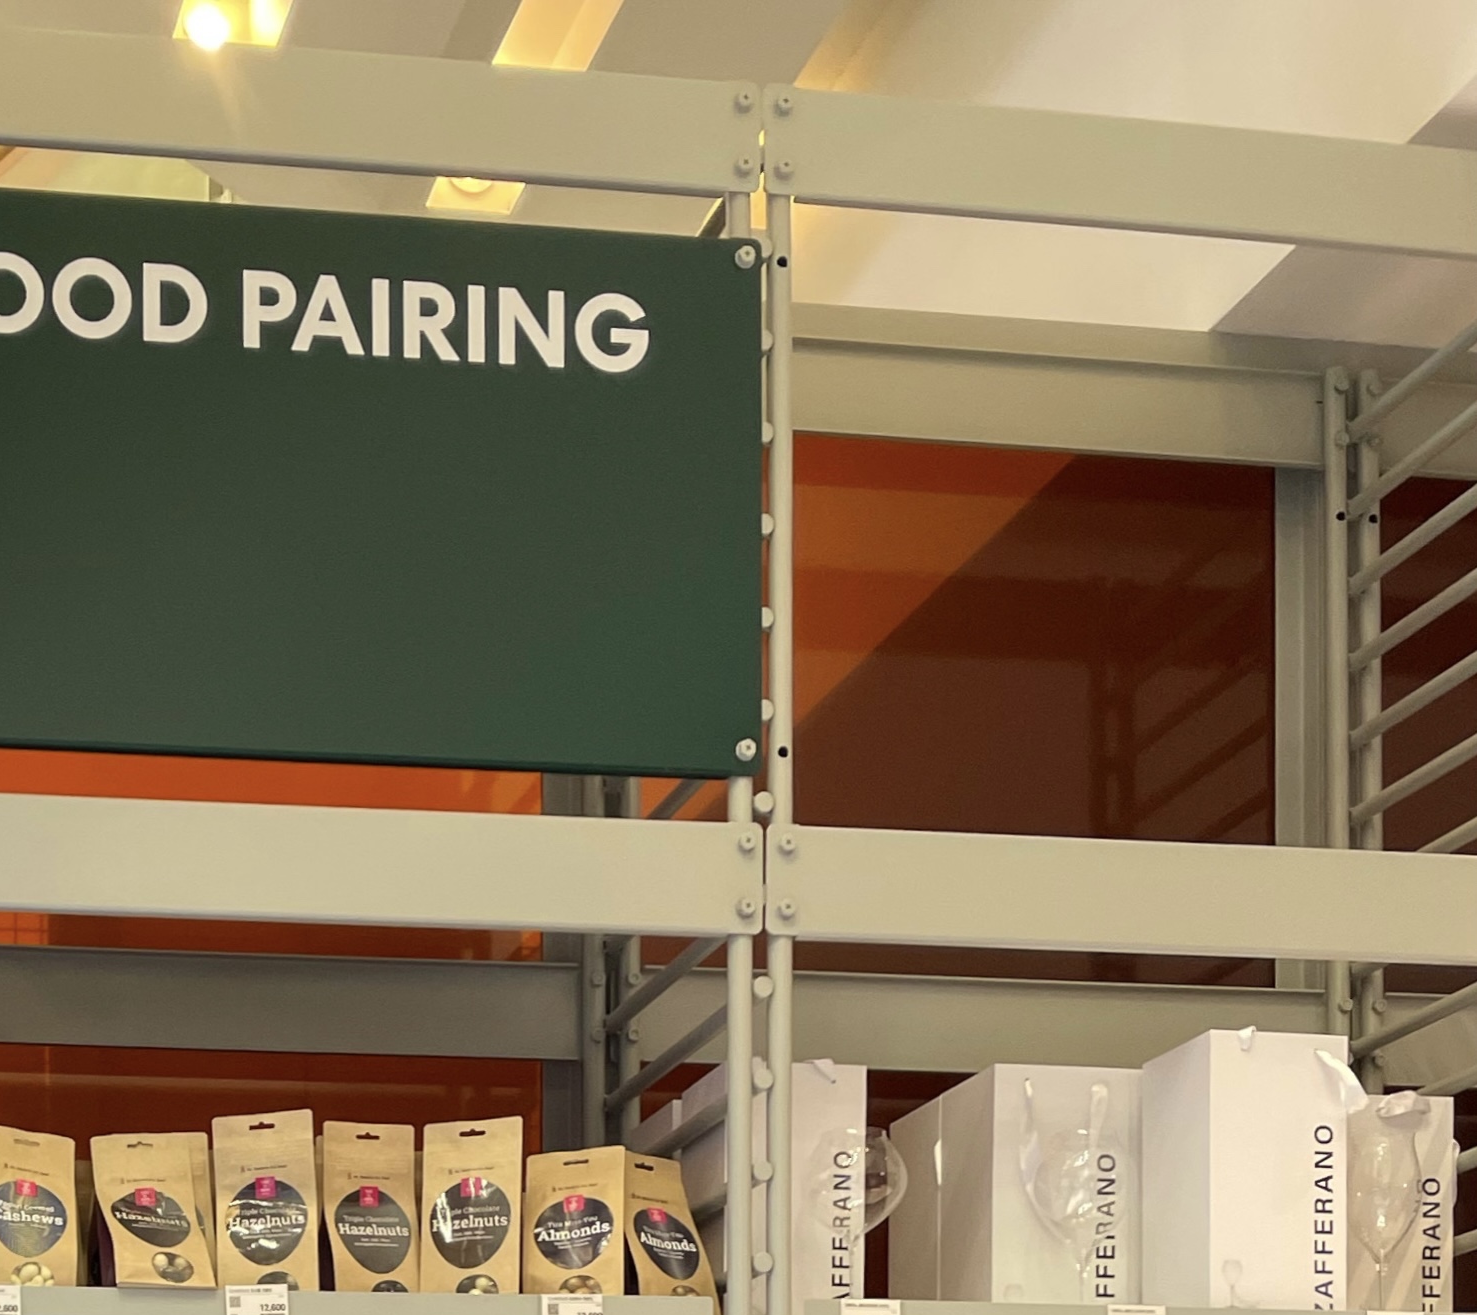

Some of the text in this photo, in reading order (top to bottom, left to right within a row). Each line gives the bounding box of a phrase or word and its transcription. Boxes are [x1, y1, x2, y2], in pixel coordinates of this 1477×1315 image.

[241, 268, 651, 374] PAIRING
[114, 1211, 189, 1228] Hazelnuts
[228, 1213, 306, 1230] Hazelnuts
[432, 1214, 509, 1233] Hzelnuts
[1094, 1152, 1116, 1298] FFERANO
[338, 1223, 410, 1237] Hazelnuts
[536, 1221, 611, 1242] Almonds
[640, 1231, 697, 1252] Almonds
